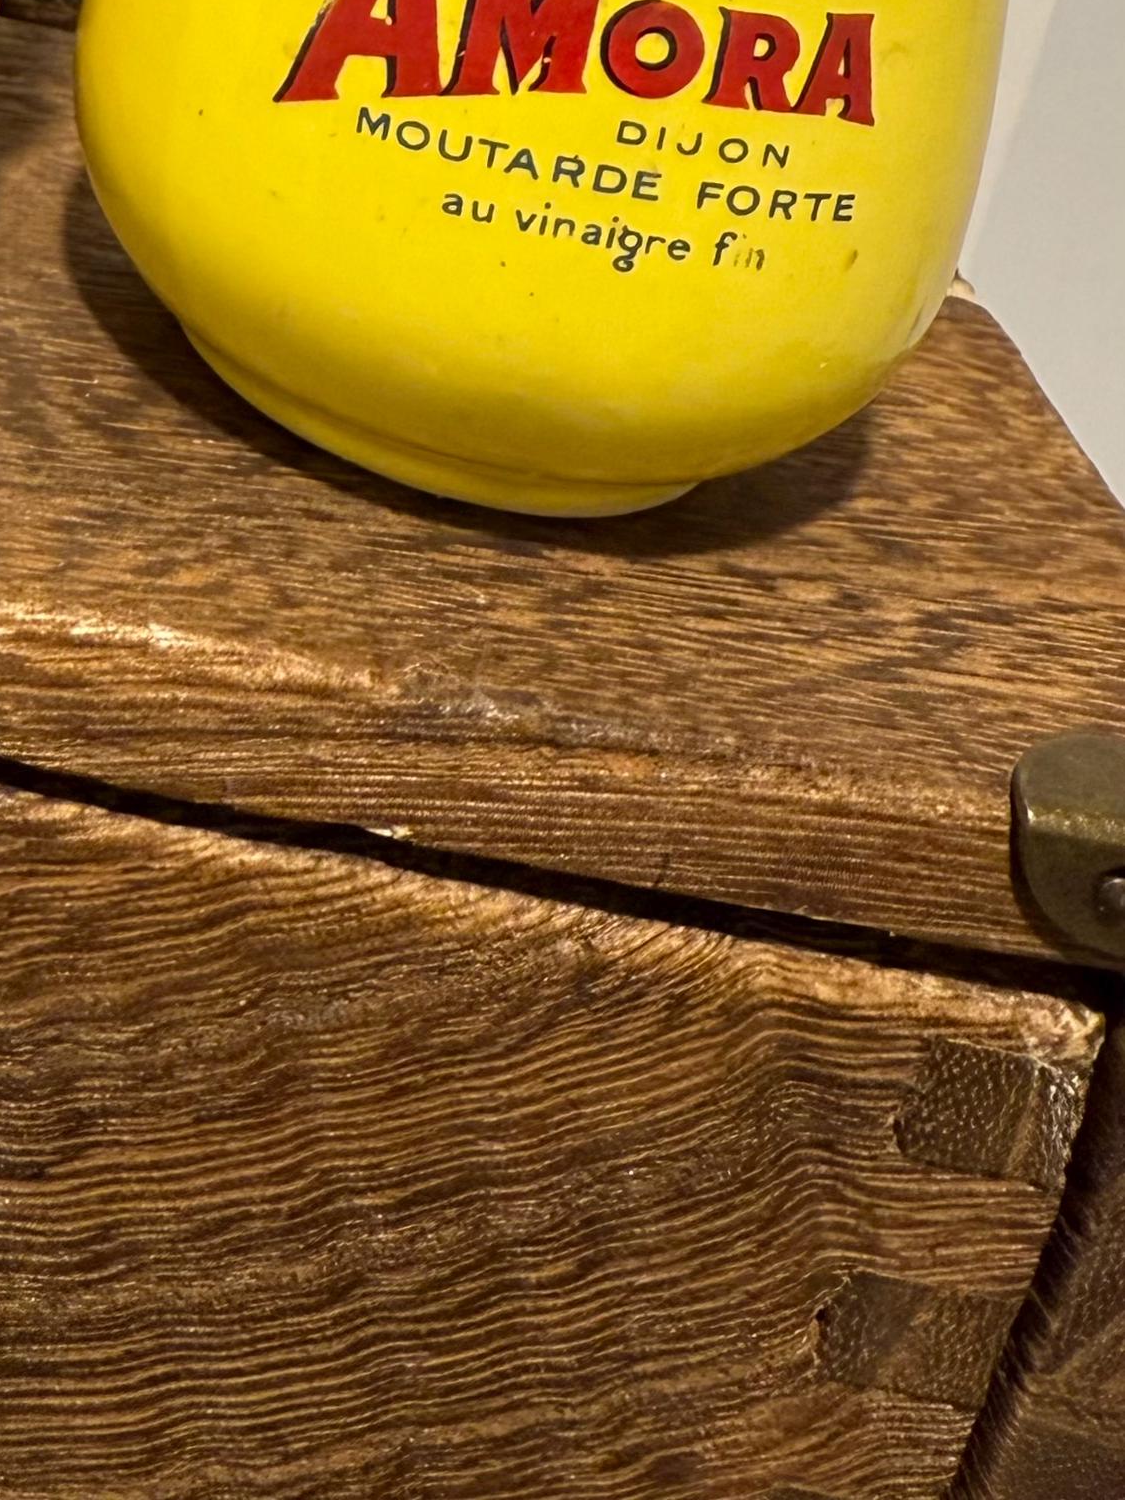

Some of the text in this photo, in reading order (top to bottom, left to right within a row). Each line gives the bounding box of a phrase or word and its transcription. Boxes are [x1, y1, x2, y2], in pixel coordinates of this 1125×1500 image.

[356, 106, 857, 222] MOUTARDE FORTE
[616, 120, 790, 168] DIJON
[441, 191, 494, 224] au
[515, 202, 691, 272] vinaigre
